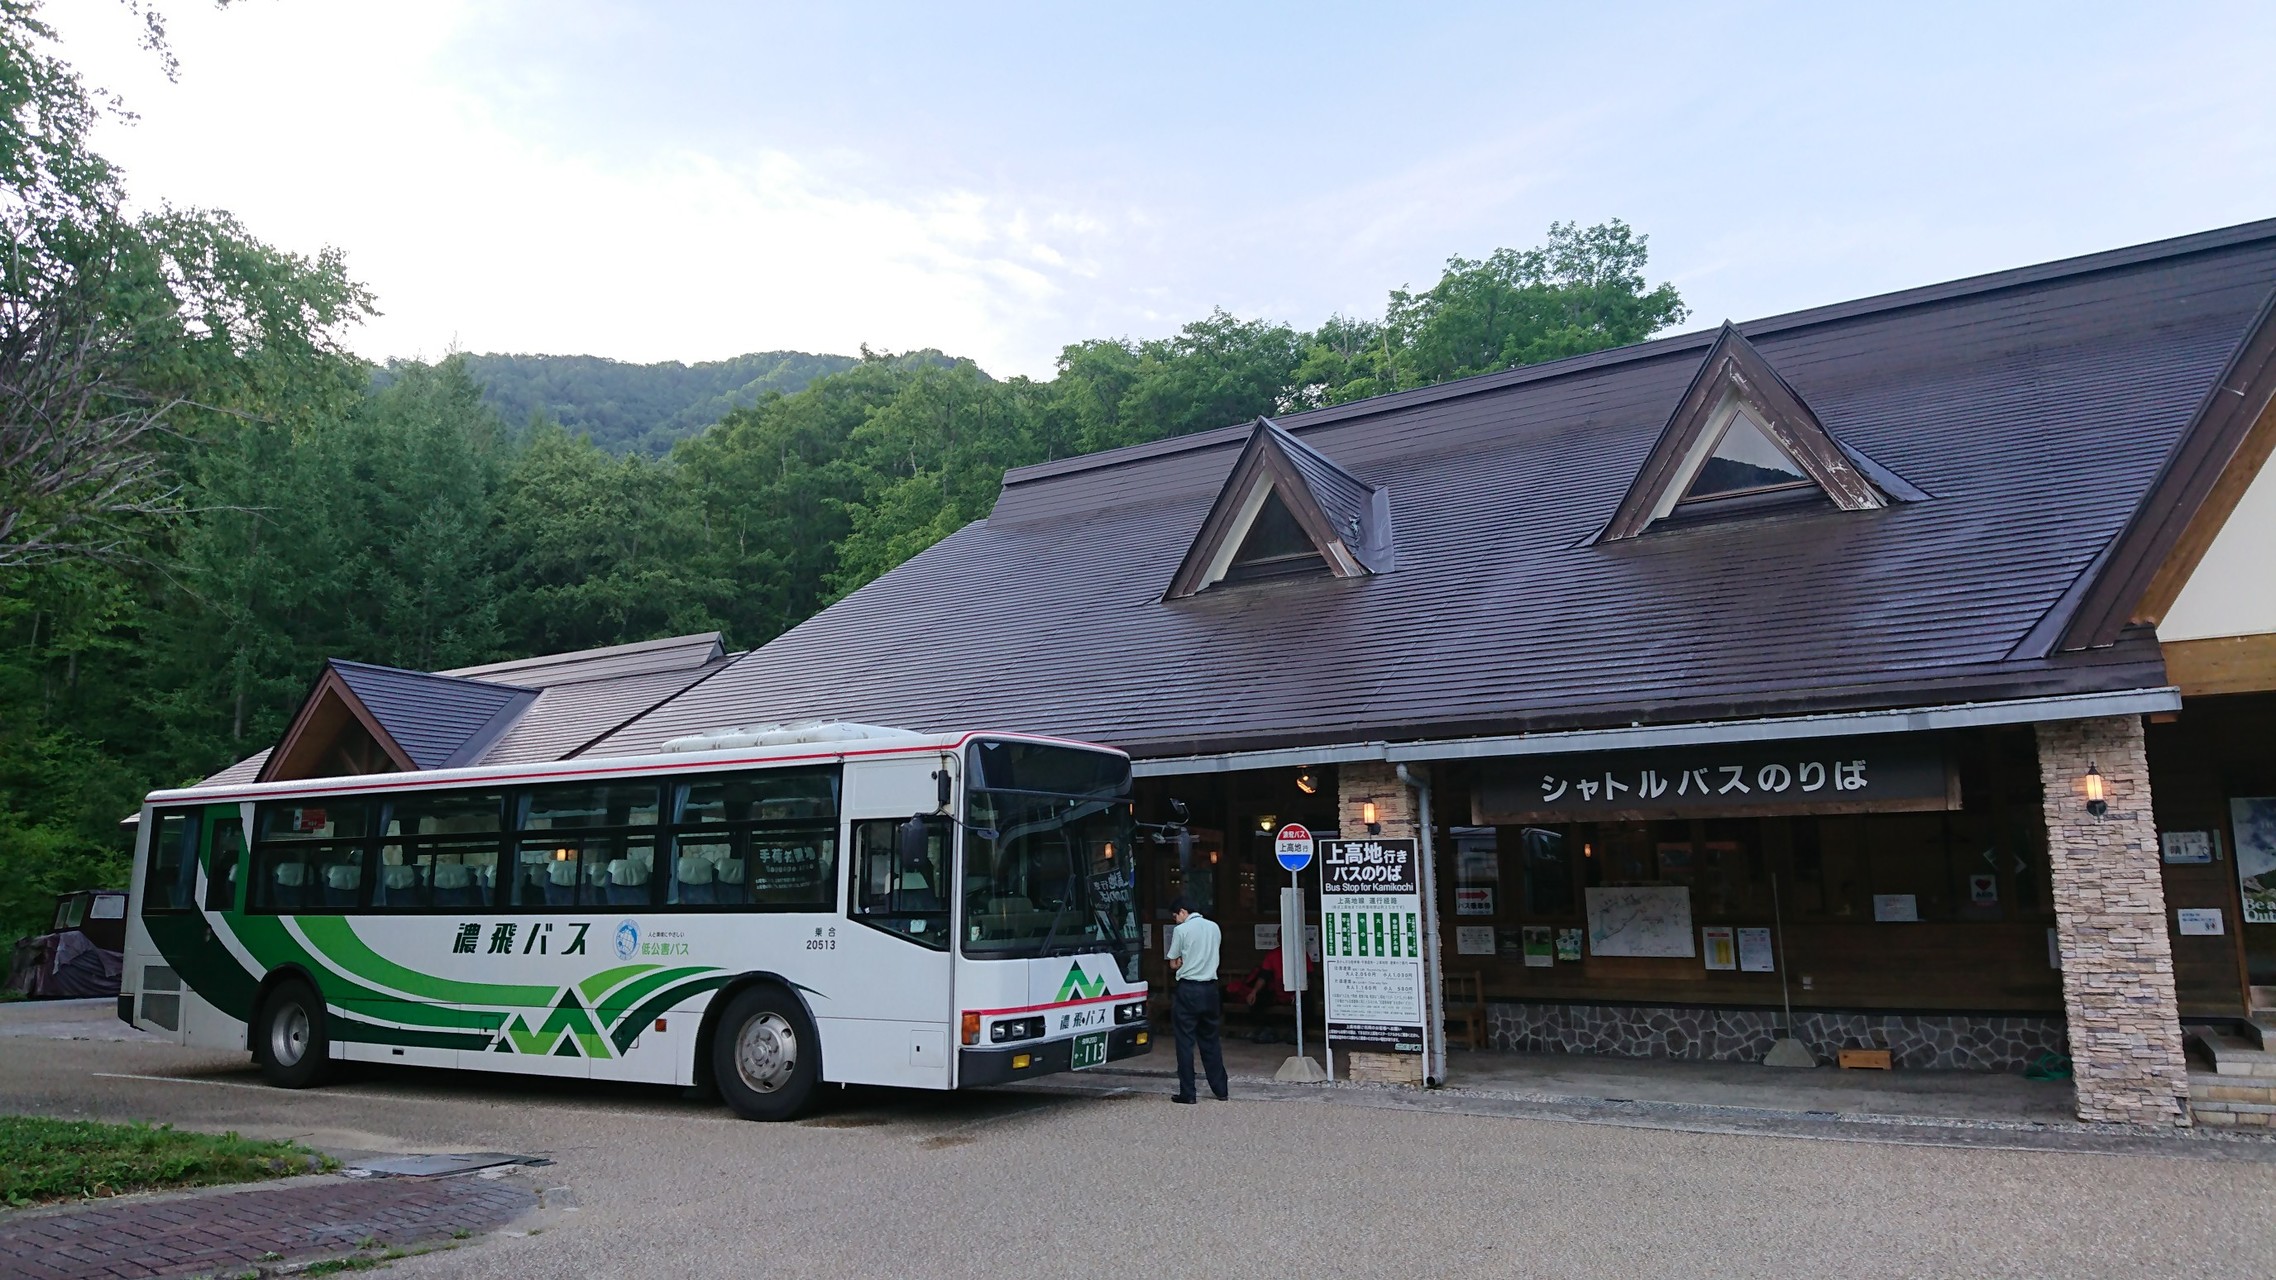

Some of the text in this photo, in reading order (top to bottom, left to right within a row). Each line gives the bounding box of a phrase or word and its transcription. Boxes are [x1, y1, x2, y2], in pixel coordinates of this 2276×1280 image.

[1541, 760, 1867, 802] シャトルバスのりば
[1280, 843, 1308, 852] 上高地行
[1326, 842, 1408, 865] 上高地行き
[1333, 865, 1403, 882] バスのりば
[1325, 883, 1414, 893] Bus Stop for Kamikochi
[452, 923, 591, 955] 濃飛バス
[806, 940, 836, 950] 20513
[641, 942, 689, 956] 低公害バス
[1060, 1008, 1106, 1030] 濃飛バス
